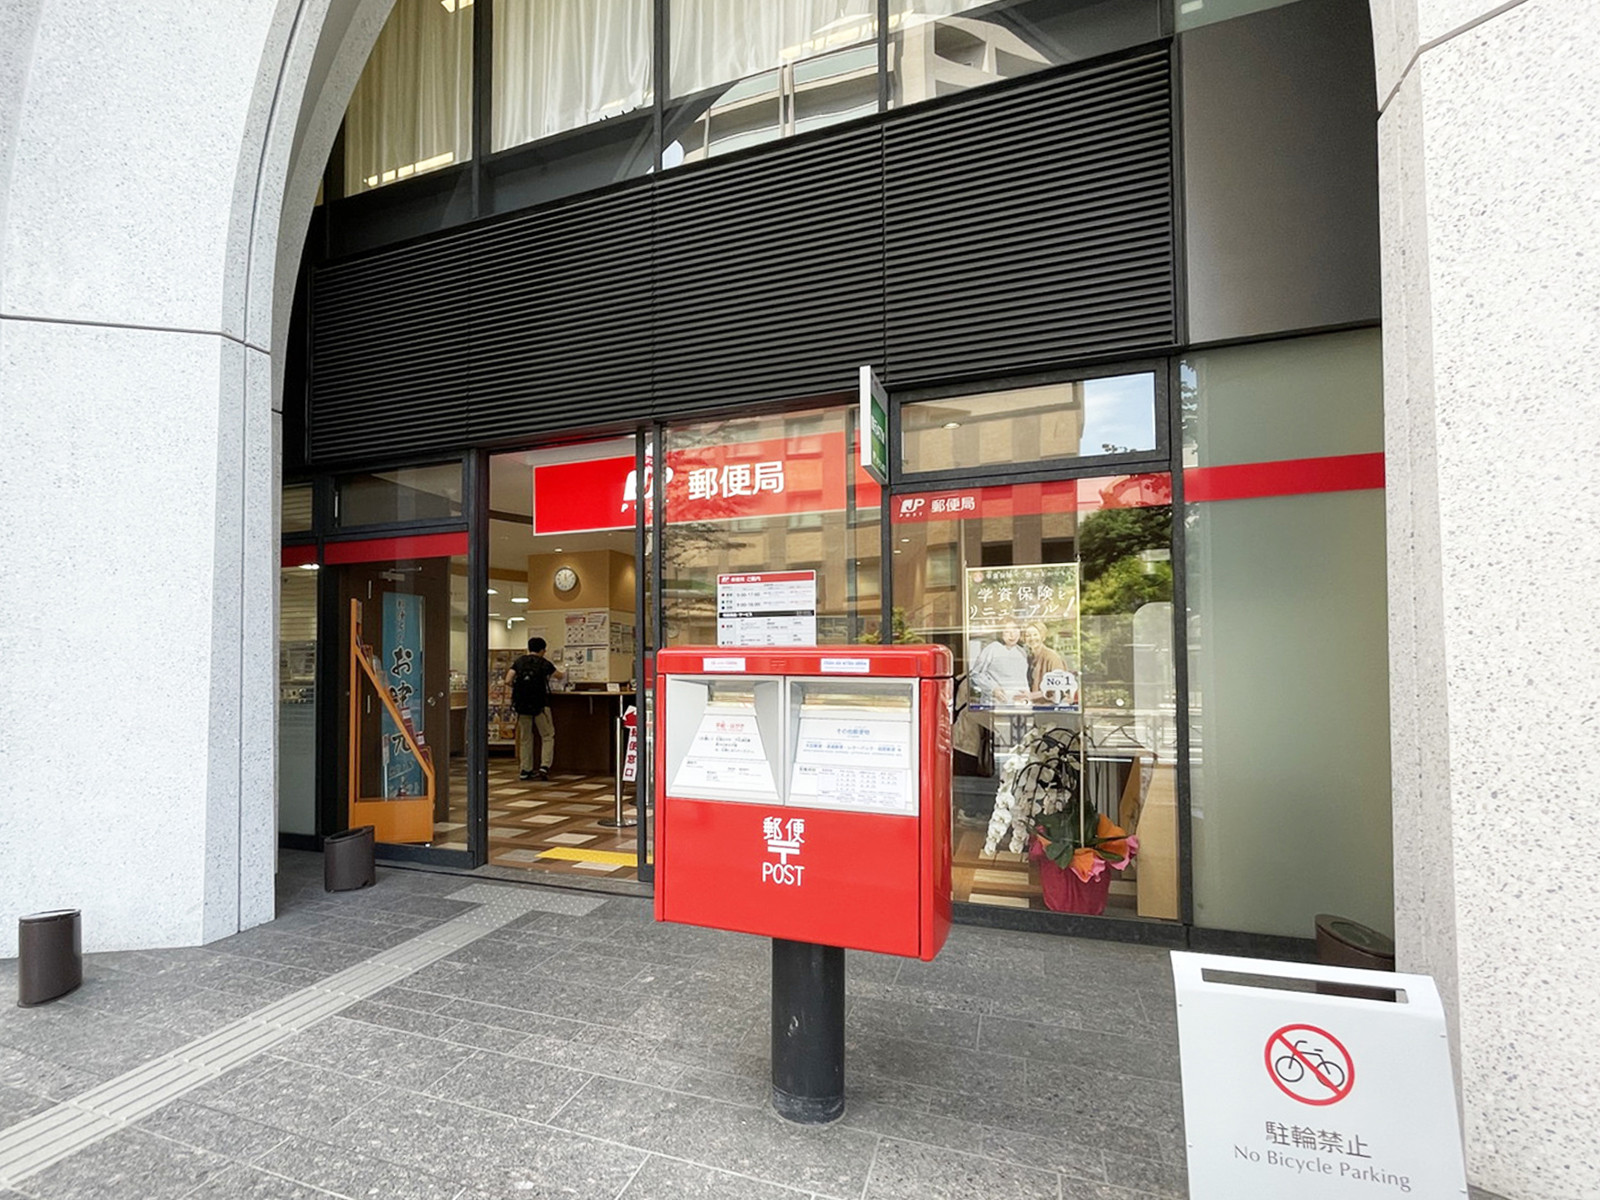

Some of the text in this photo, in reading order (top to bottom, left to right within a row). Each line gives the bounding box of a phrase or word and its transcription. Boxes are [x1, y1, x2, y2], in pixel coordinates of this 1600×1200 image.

[688, 461, 784, 501] 郵便局
[931, 497, 976, 513] 郵便局
[762, 816, 806, 844] 郵便
[762, 861, 806, 887] POST
[1265, 1120, 1372, 1159] 駐輪禁止
[1233, 1144, 1412, 1192] No Bicycle Parking
